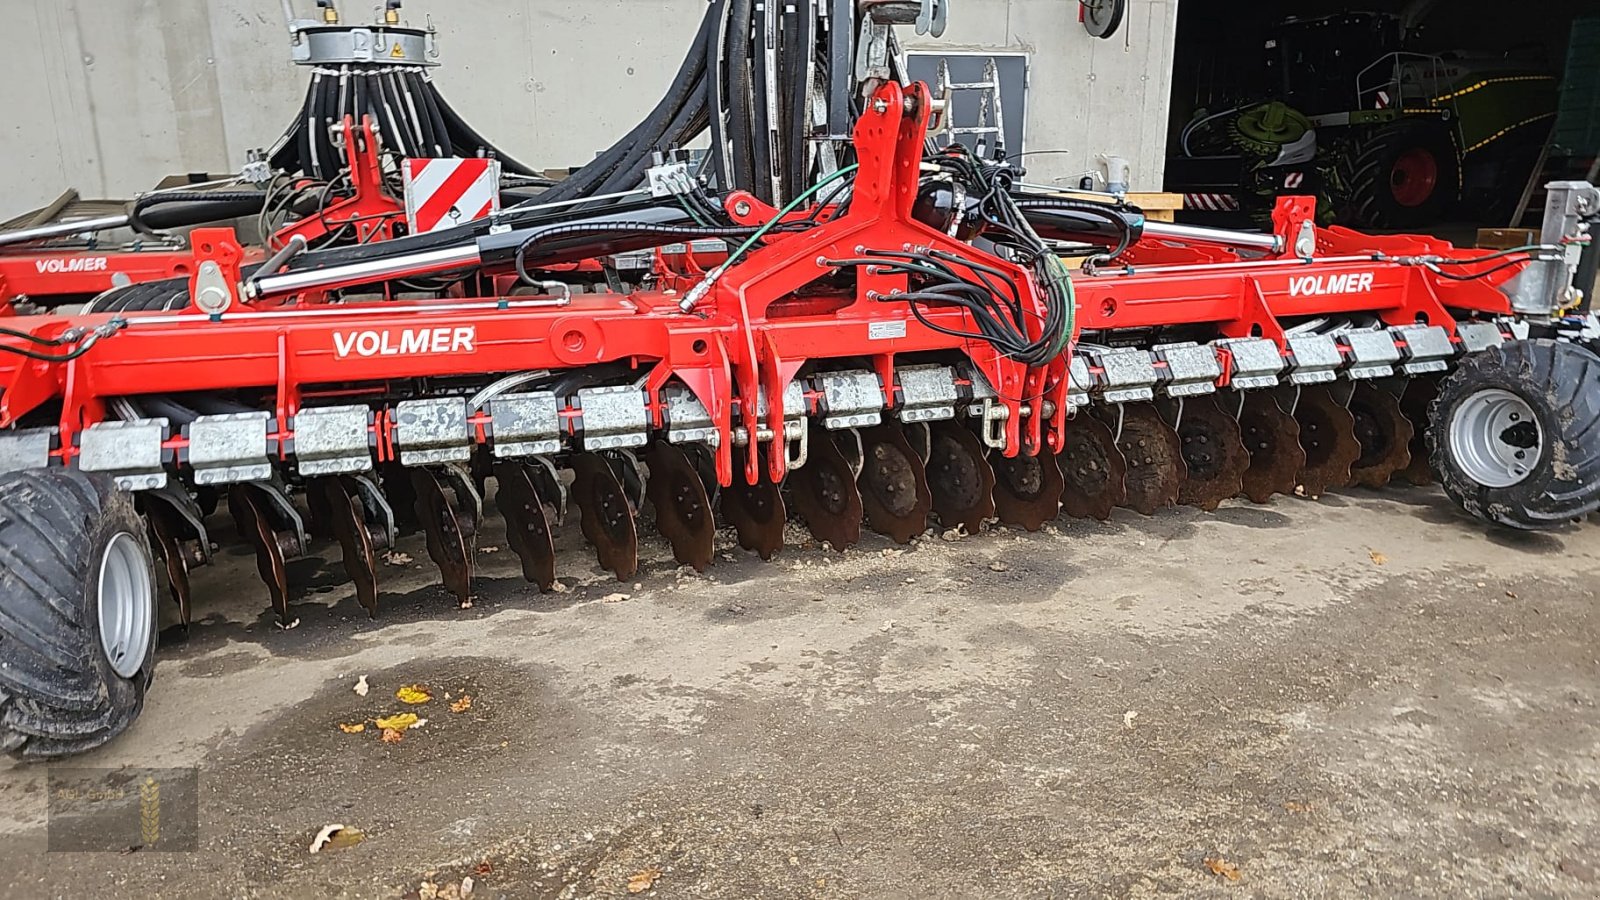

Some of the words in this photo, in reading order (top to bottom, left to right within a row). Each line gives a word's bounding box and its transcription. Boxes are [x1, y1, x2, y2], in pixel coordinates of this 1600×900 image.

[35, 257, 107, 274] VOLMER
[1289, 272, 1373, 297] VOLMER
[333, 327, 475, 357] VOLMER
